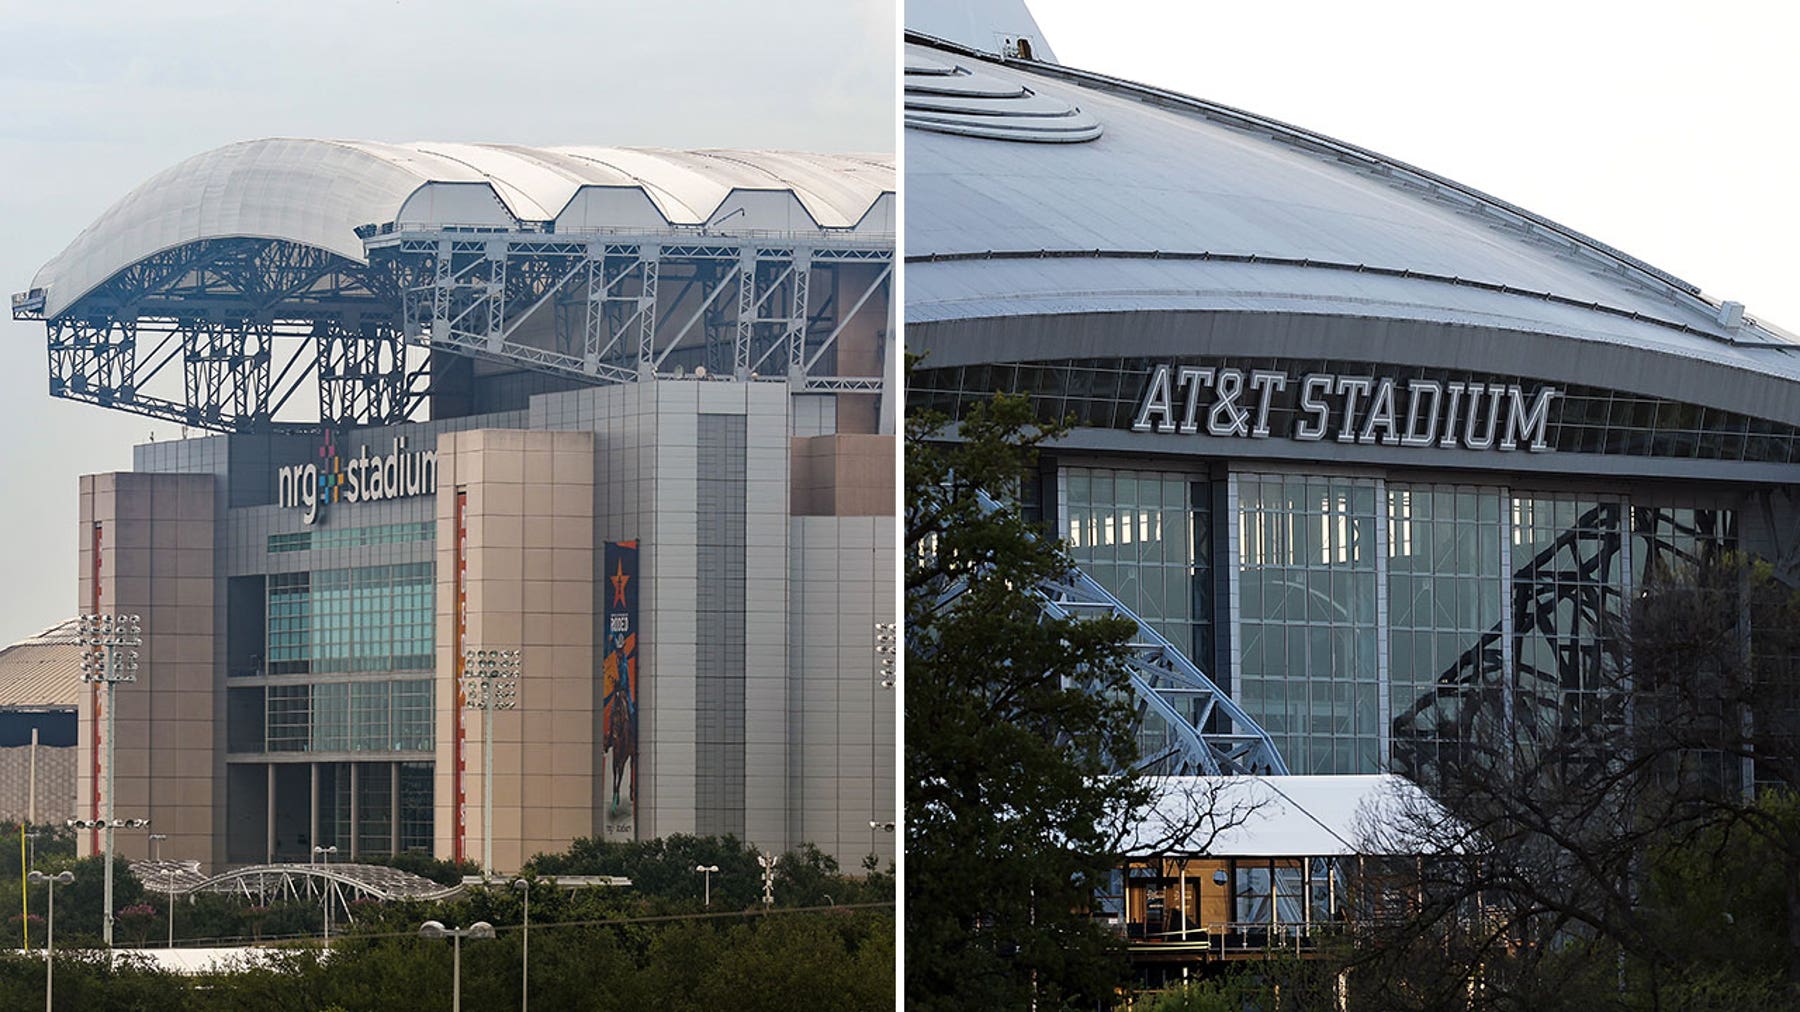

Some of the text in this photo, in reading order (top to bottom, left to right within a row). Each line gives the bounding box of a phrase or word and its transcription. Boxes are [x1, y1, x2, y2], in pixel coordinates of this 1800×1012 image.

[1131, 364, 1556, 453] AT&T STADIUM
[279, 436, 438, 525] nrg stadium
